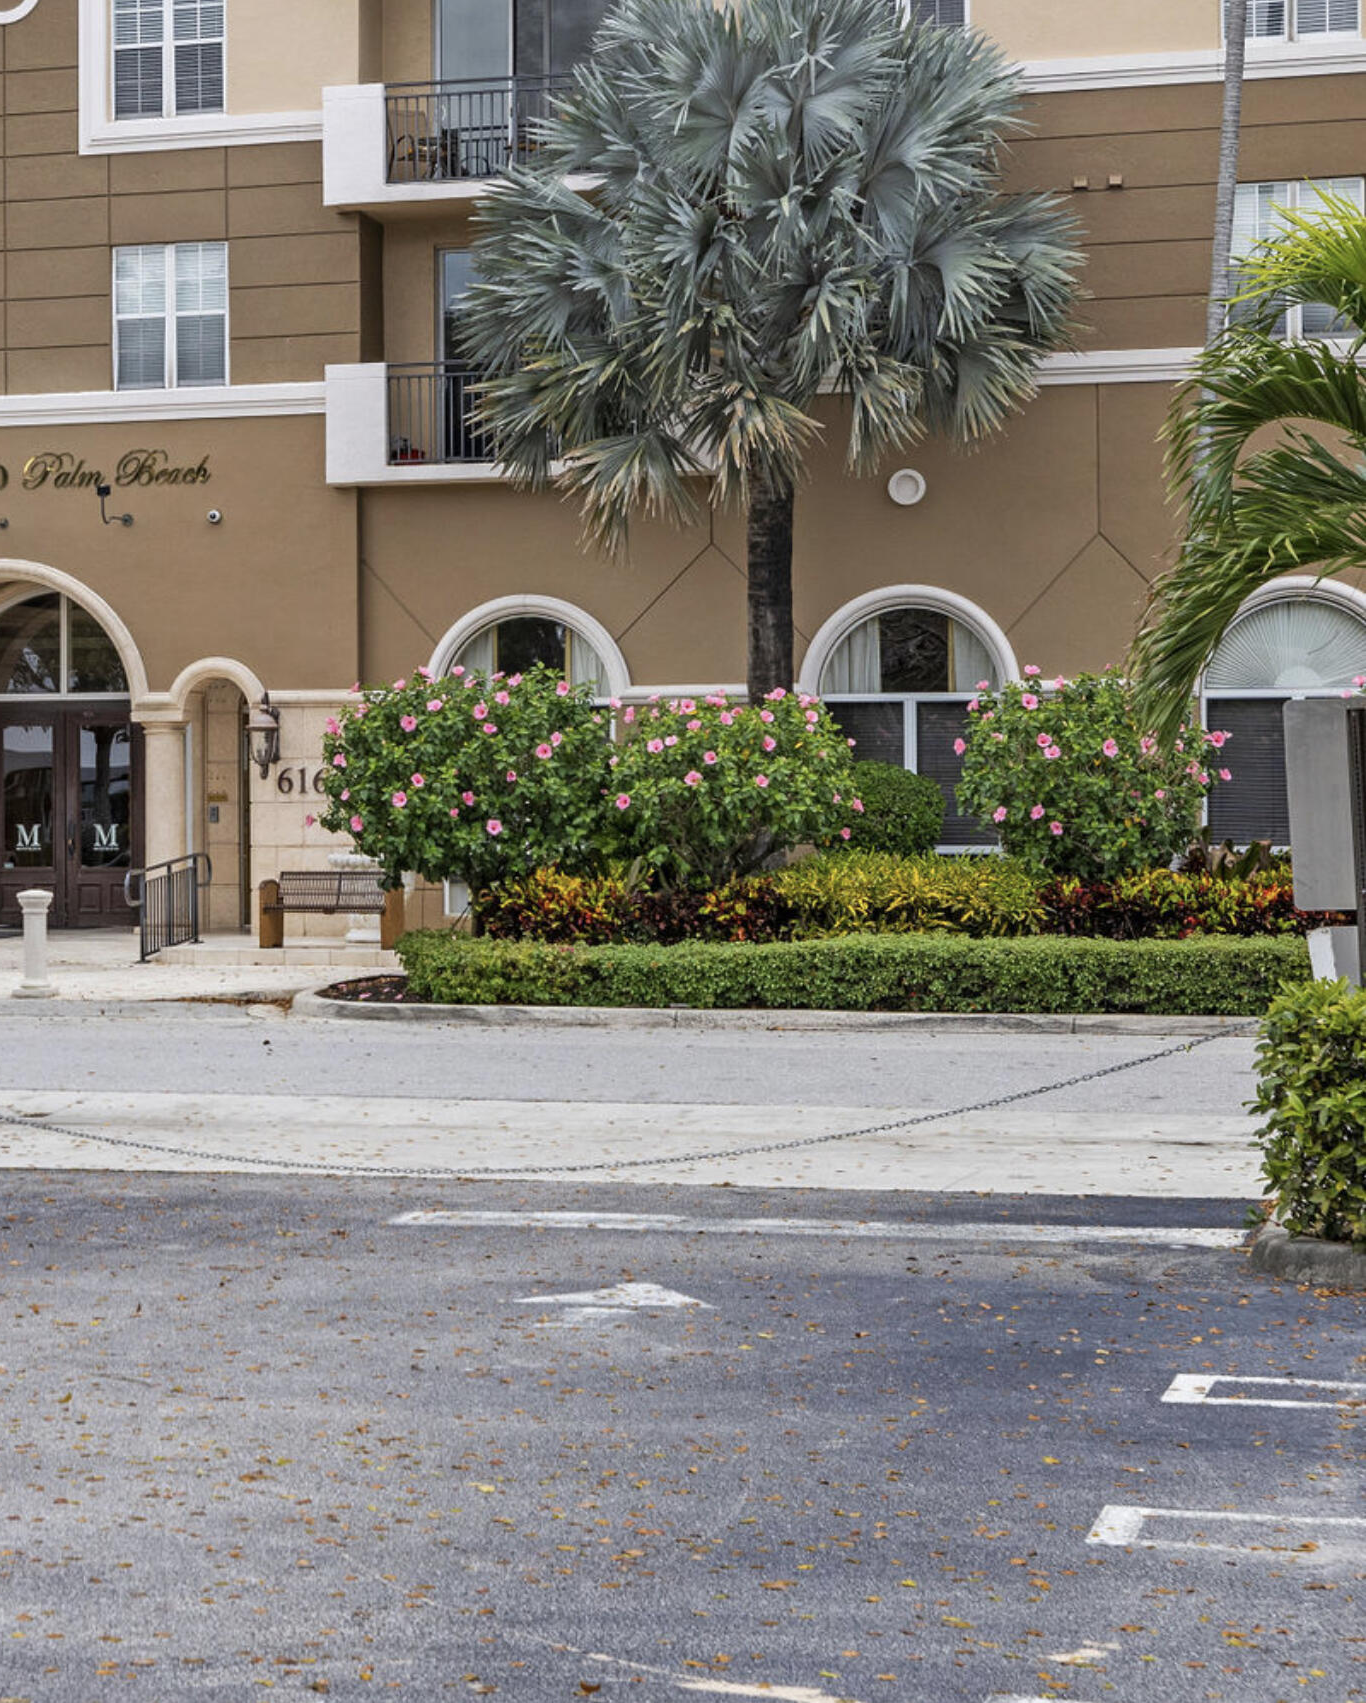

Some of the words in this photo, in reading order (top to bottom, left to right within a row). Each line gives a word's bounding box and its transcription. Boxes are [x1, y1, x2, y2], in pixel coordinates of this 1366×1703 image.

[21, 452, 105, 490] Palm
[114, 449, 211, 487] Beach
[16, 823, 42, 847] M
[93, 823, 120, 847] M
